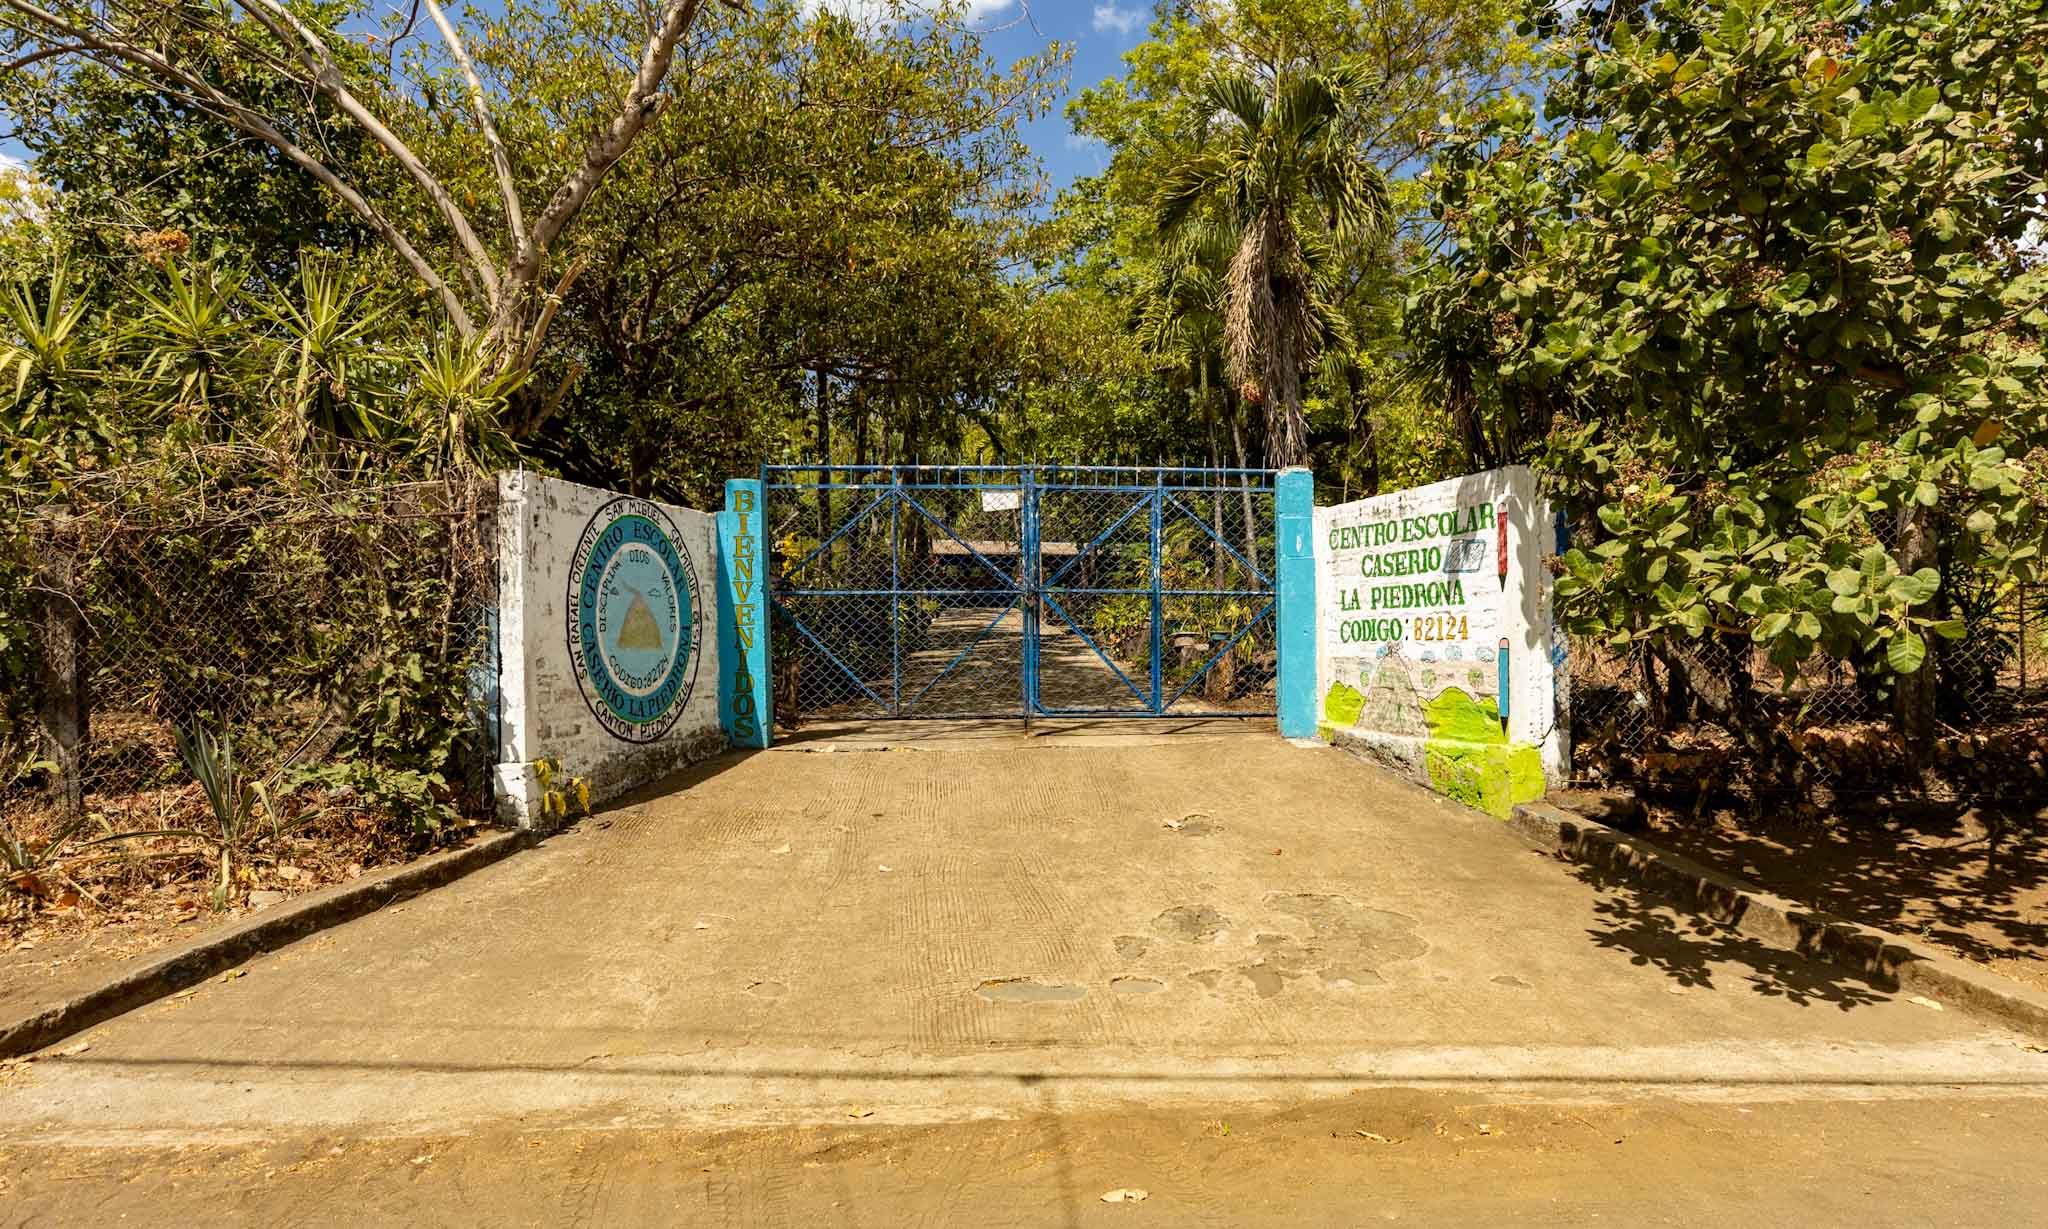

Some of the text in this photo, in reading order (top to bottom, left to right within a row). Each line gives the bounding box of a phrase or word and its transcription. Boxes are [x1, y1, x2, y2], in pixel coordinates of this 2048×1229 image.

[606, 501, 661, 525] SAN MIGUEL
[1329, 502, 1497, 550] CENTRO ESCOLAR
[583, 520, 685, 609] CENTRO ESCOLAR
[630, 549, 650, 564] DIOS
[669, 529, 682, 554] SAN
[681, 553, 697, 600] MIGUEL
[1361, 546, 1441, 578] CASERIO
[570, 523, 600, 680] SAN RAFAEL ORIENTE
[662, 570, 676, 632] VALORES
[733, 490, 754, 739] BIENVENIDOS
[1340, 580, 1465, 611] LA PIEDRONA
[1413, 615, 1468, 641] 82124
[583, 624, 690, 717] CASERIO LA PIEDRONA
[596, 680, 691, 738] CANTON PIEDRA AZUL
